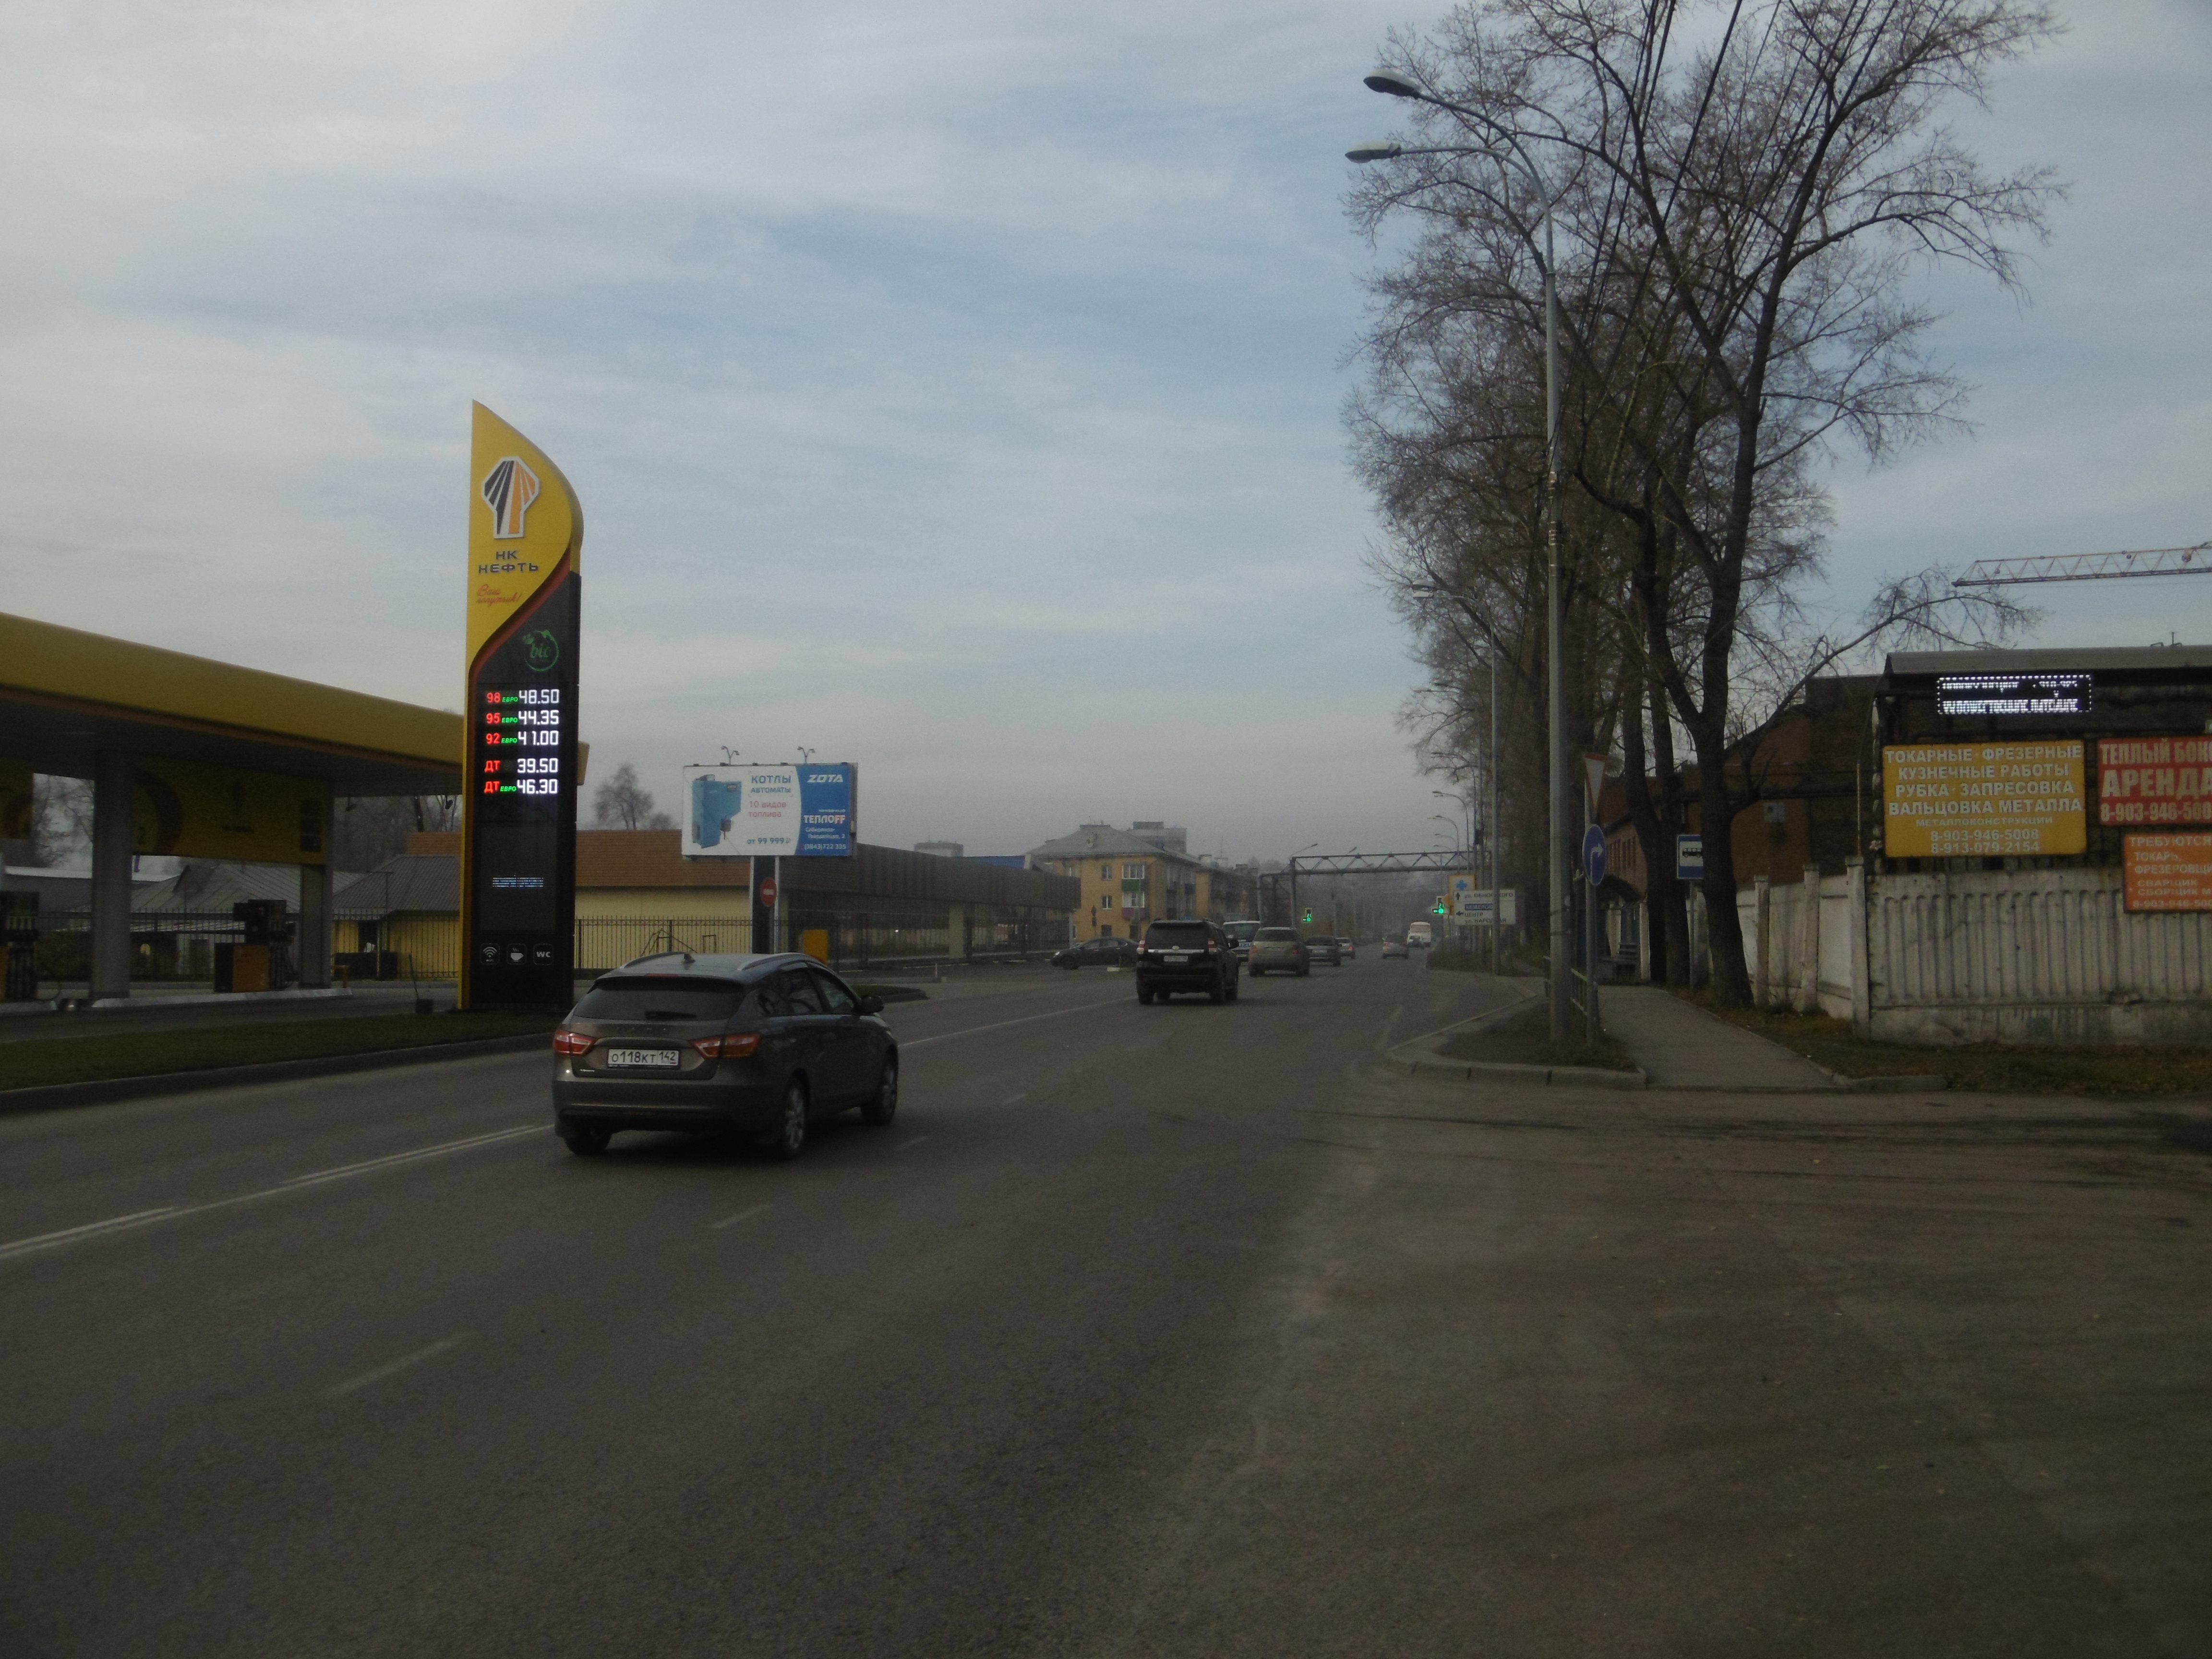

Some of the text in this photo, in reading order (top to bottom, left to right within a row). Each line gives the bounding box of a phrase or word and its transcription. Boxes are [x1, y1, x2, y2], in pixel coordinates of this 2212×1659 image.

[496, 550, 518, 560] НК
[478, 562, 539, 574] НЕФТЬ
[486, 692, 501, 703] 98
[519, 689, 559, 704] 48.50
[486, 713, 500, 724] 95
[518, 710, 559, 725] 44.35
[486, 733, 501, 744] 92
[518, 731, 558, 745] 41.00
[1885, 745, 2082, 763] ТОКАРНЫЕ ФРЕЗЕРНЫЕ
[2100, 738, 2171, 765] ТЕПЛЫЙ
[484, 758, 558, 773] ДТ 39.50
[1898, 763, 2069, 781] КУЗНЕЧНЫЕ РАБОТЫ
[751, 775, 791, 783] КОТЛЫ
[807, 774, 843, 783] ZOTA
[484, 781, 500, 793] ДТ
[517, 779, 558, 794] 46.30
[1895, 780, 2075, 797] РУБКА ЗАПРЕСОВКА
[1888, 798, 2082, 817] ВАЛЬЦОВКА МЕТАЛЛА
[1916, 817, 2053, 827] МЕТАЛЛОКОНСТРУКЦИИ
[1931, 829, 2039, 842] 8-903-946-5008
[2129, 835, 2212, 846] ТРЕБУЮТСЯ
[1931, 841, 2040, 854] 8-913-079-2154
[659, 1051, 676, 1061] 142
